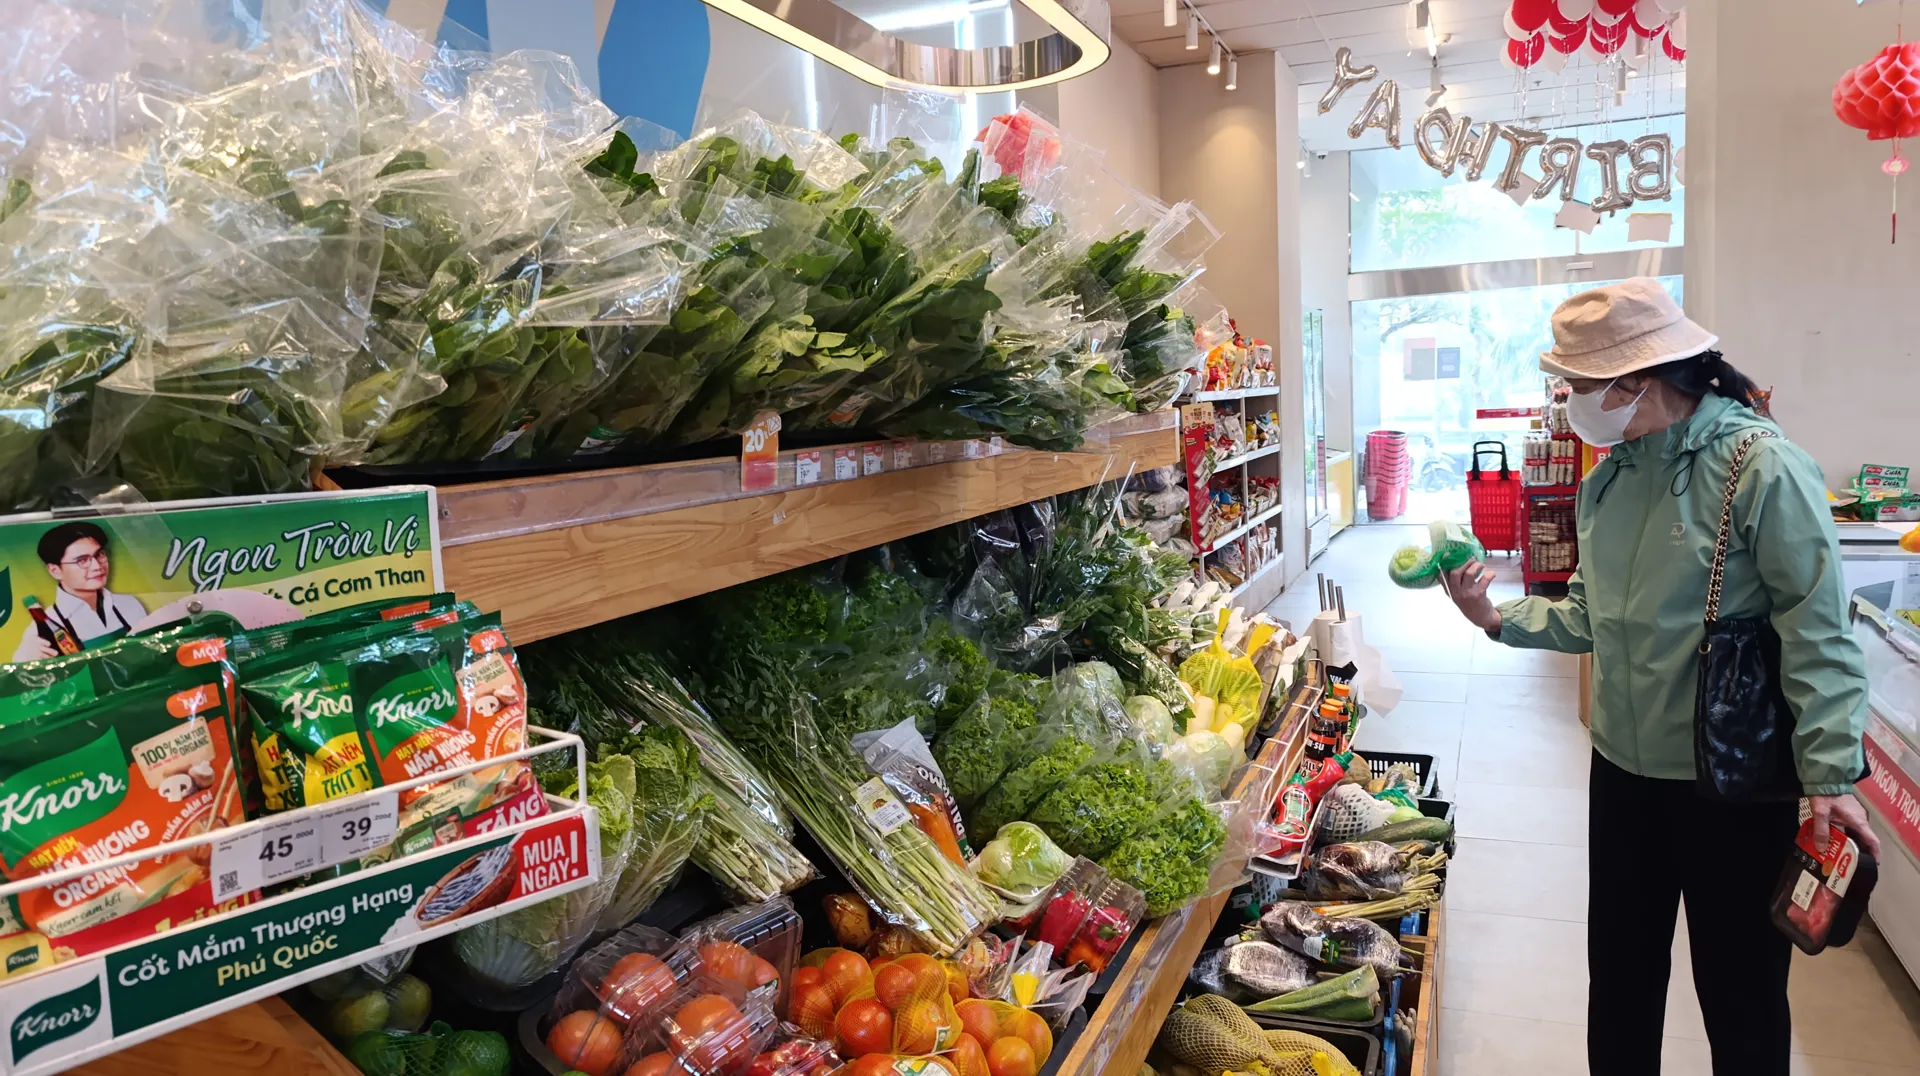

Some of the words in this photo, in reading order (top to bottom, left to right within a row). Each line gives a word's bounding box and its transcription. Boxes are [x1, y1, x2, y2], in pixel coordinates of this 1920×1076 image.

[162, 537, 280, 592] Ngon
[282, 520, 377, 568] Tròn
[384, 515, 421, 557] Vị
[288, 583, 320, 606] Cá
[324, 576, 372, 599] Cơm
[375, 567, 425, 588] Than
[281, 689, 354, 728] Kno
[369, 688, 456, 728] Knorr
[140, 741, 178, 767] 100%
[0, 772, 123, 832] Knorr
[259, 834, 294, 862] 45
[341, 816, 372, 841] 39
[522, 835, 566, 869] MUA
[118, 957, 170, 987] Cốt
[177, 931, 246, 970] Mắm
[251, 904, 347, 946] Thượng
[352, 881, 414, 915] Hạng
[217, 951, 266, 987] Phú
[272, 929, 339, 969] Quốc
[15, 1004, 98, 1042] Knorr
